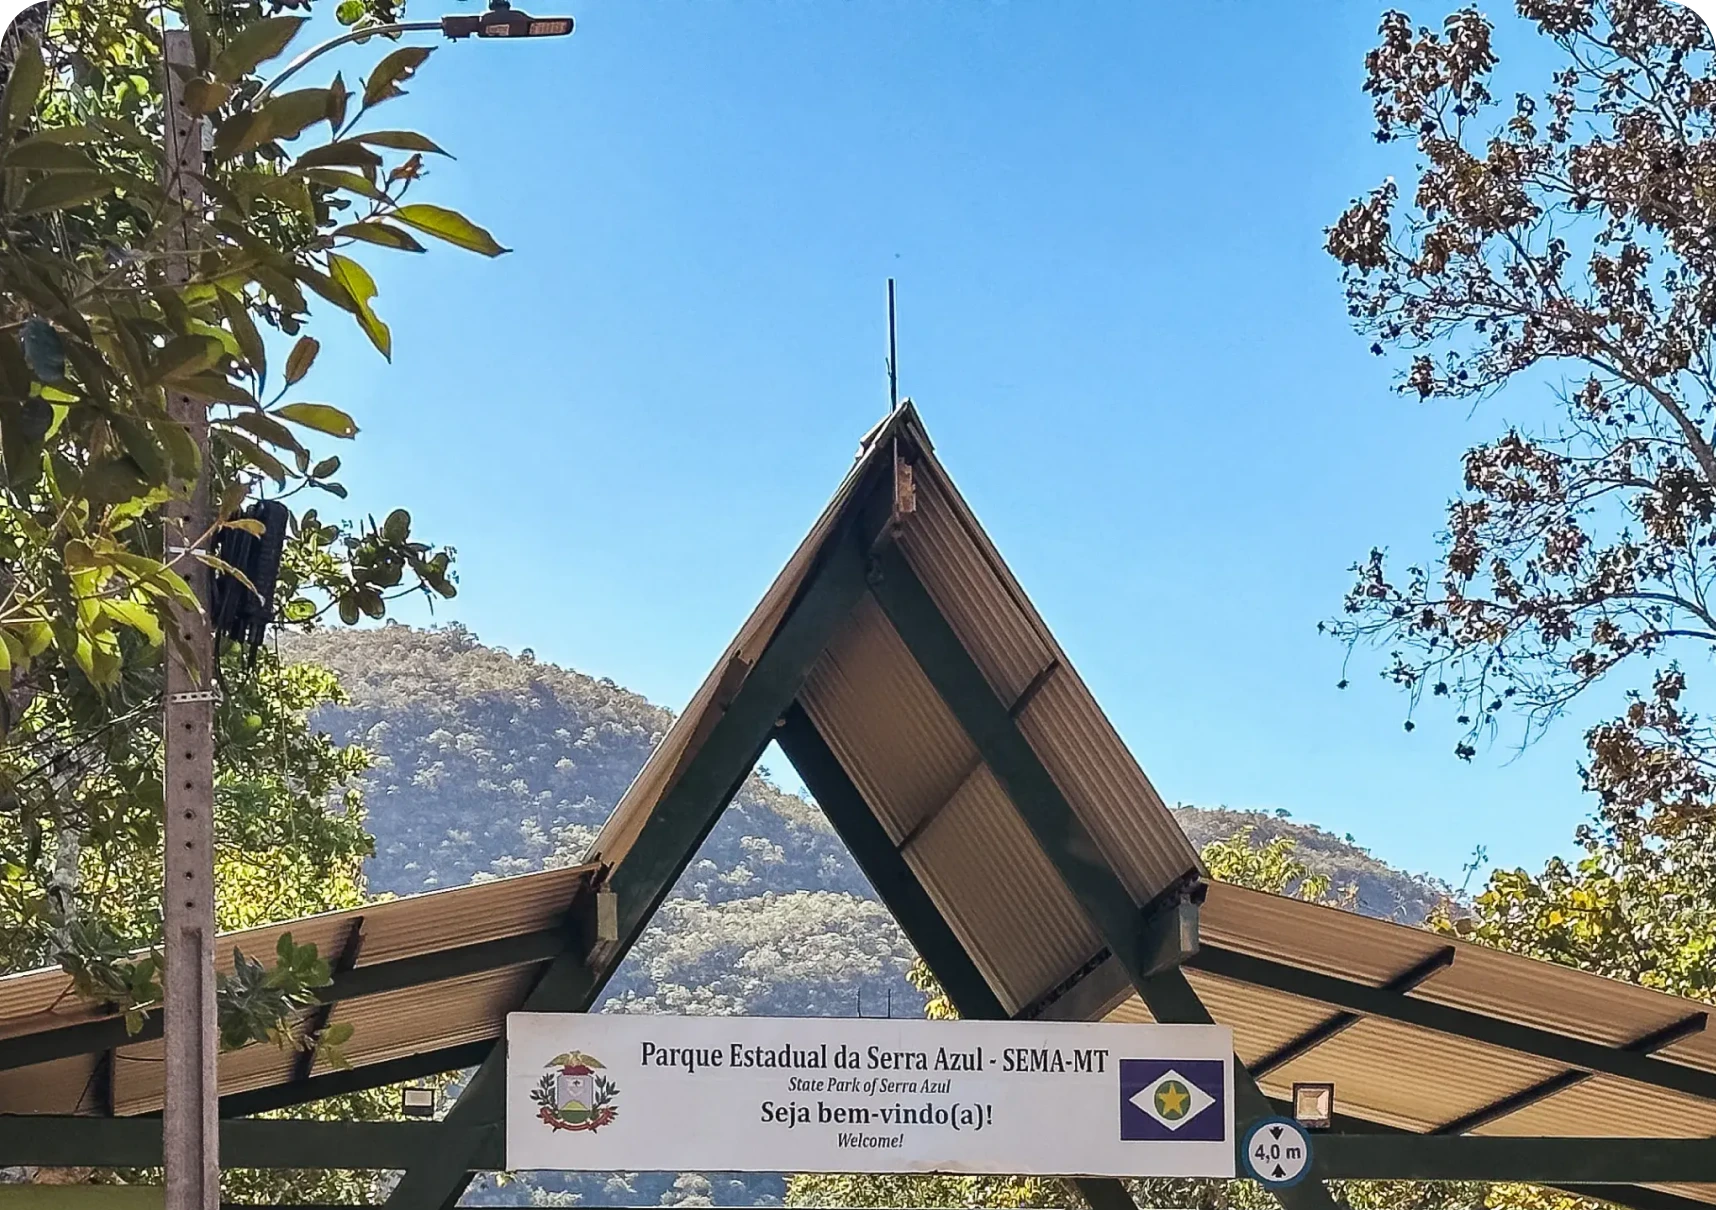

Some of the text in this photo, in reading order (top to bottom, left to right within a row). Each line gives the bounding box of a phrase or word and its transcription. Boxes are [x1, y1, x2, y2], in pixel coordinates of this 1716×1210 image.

[640, 1041, 723, 1074] Parque
[729, 1043, 828, 1069] Estadual
[834, 1044, 861, 1070] da
[867, 1046, 928, 1071] Serra
[934, 1047, 984, 1072] Azul
[1002, 1048, 1109, 1074] SEMA-MT
[788, 1076, 951, 1097] State Park of Serra Azul
[761, 1101, 993, 1131] Seja bem-vindo(a)!
[837, 1132, 904, 1149] Welcome!
[1255, 1144, 1301, 1164] 4,0 m
